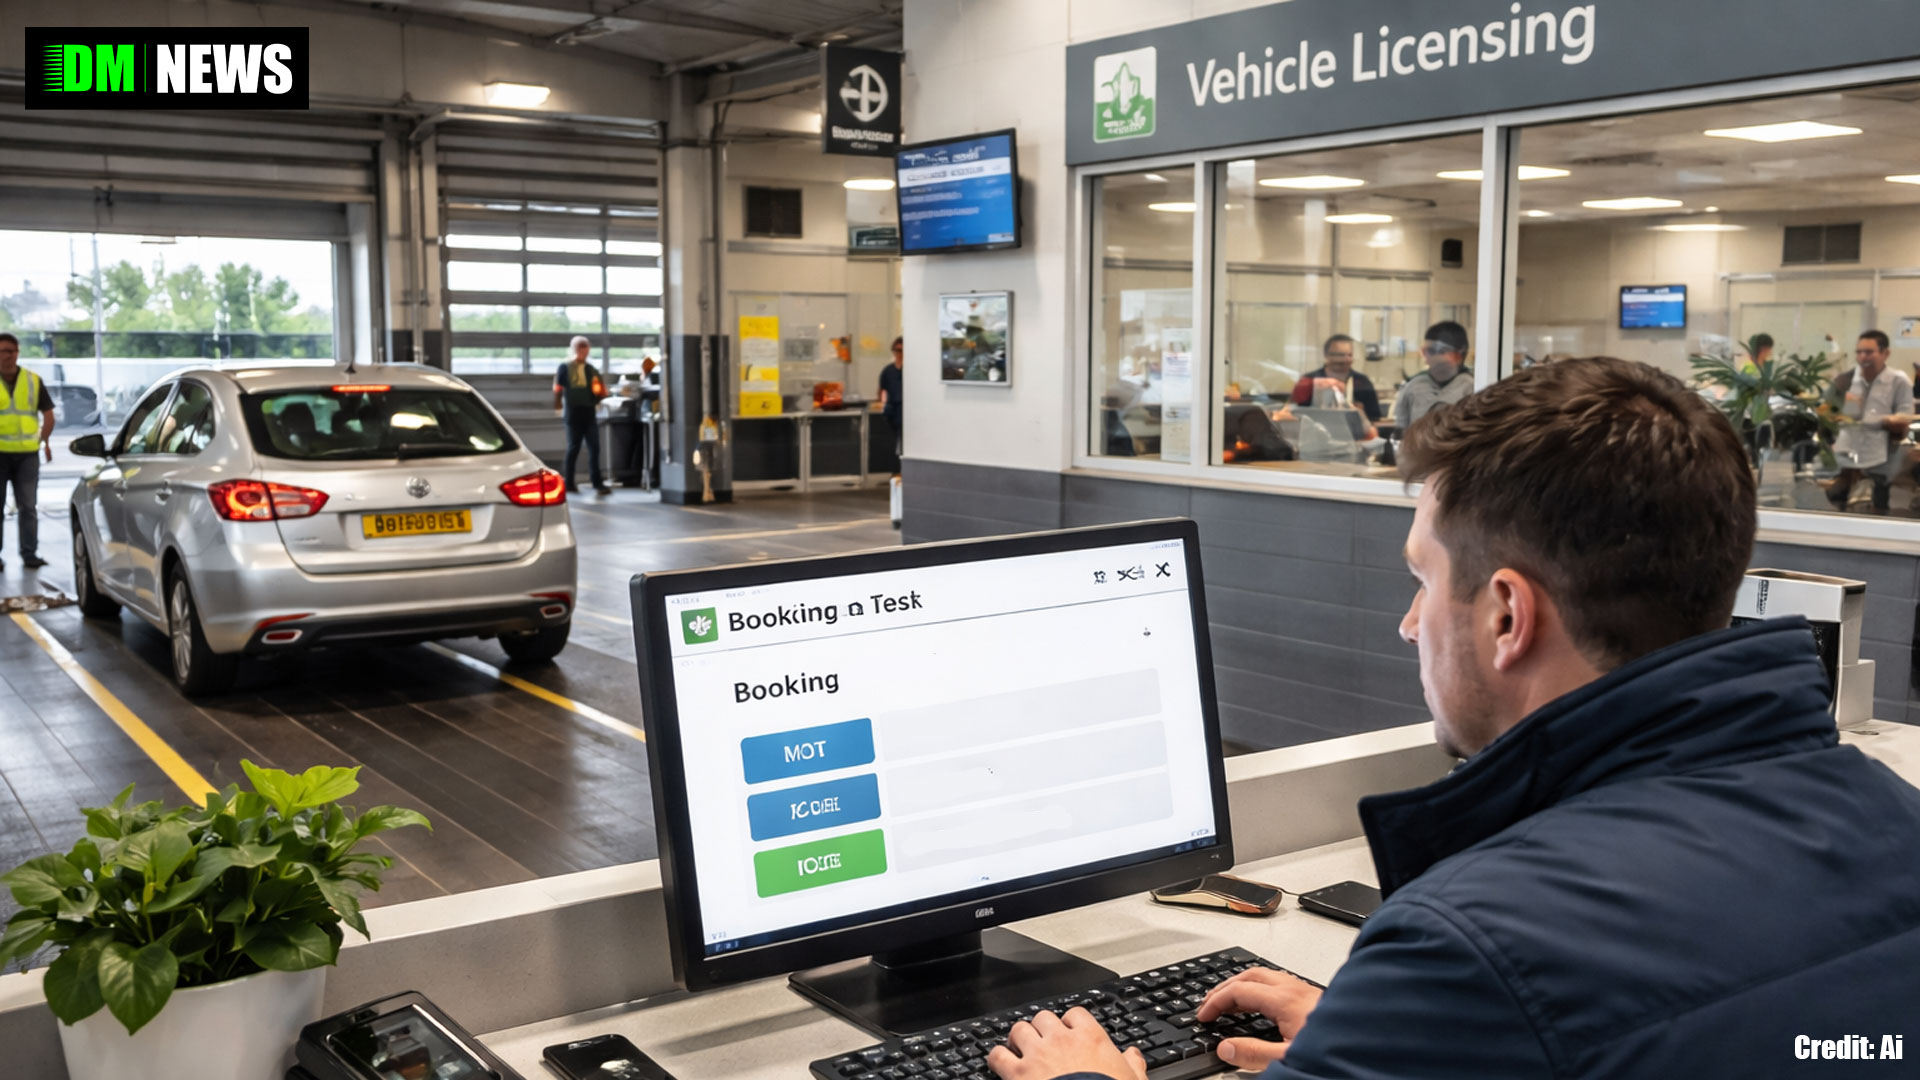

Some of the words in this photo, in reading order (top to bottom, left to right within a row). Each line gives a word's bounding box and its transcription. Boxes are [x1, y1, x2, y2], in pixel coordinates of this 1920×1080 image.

[1186, 40, 1337, 106] Vehicle
[1352, 2, 1596, 82] Licensing
[734, 672, 839, 703] Booking
[783, 740, 827, 763] MOT
